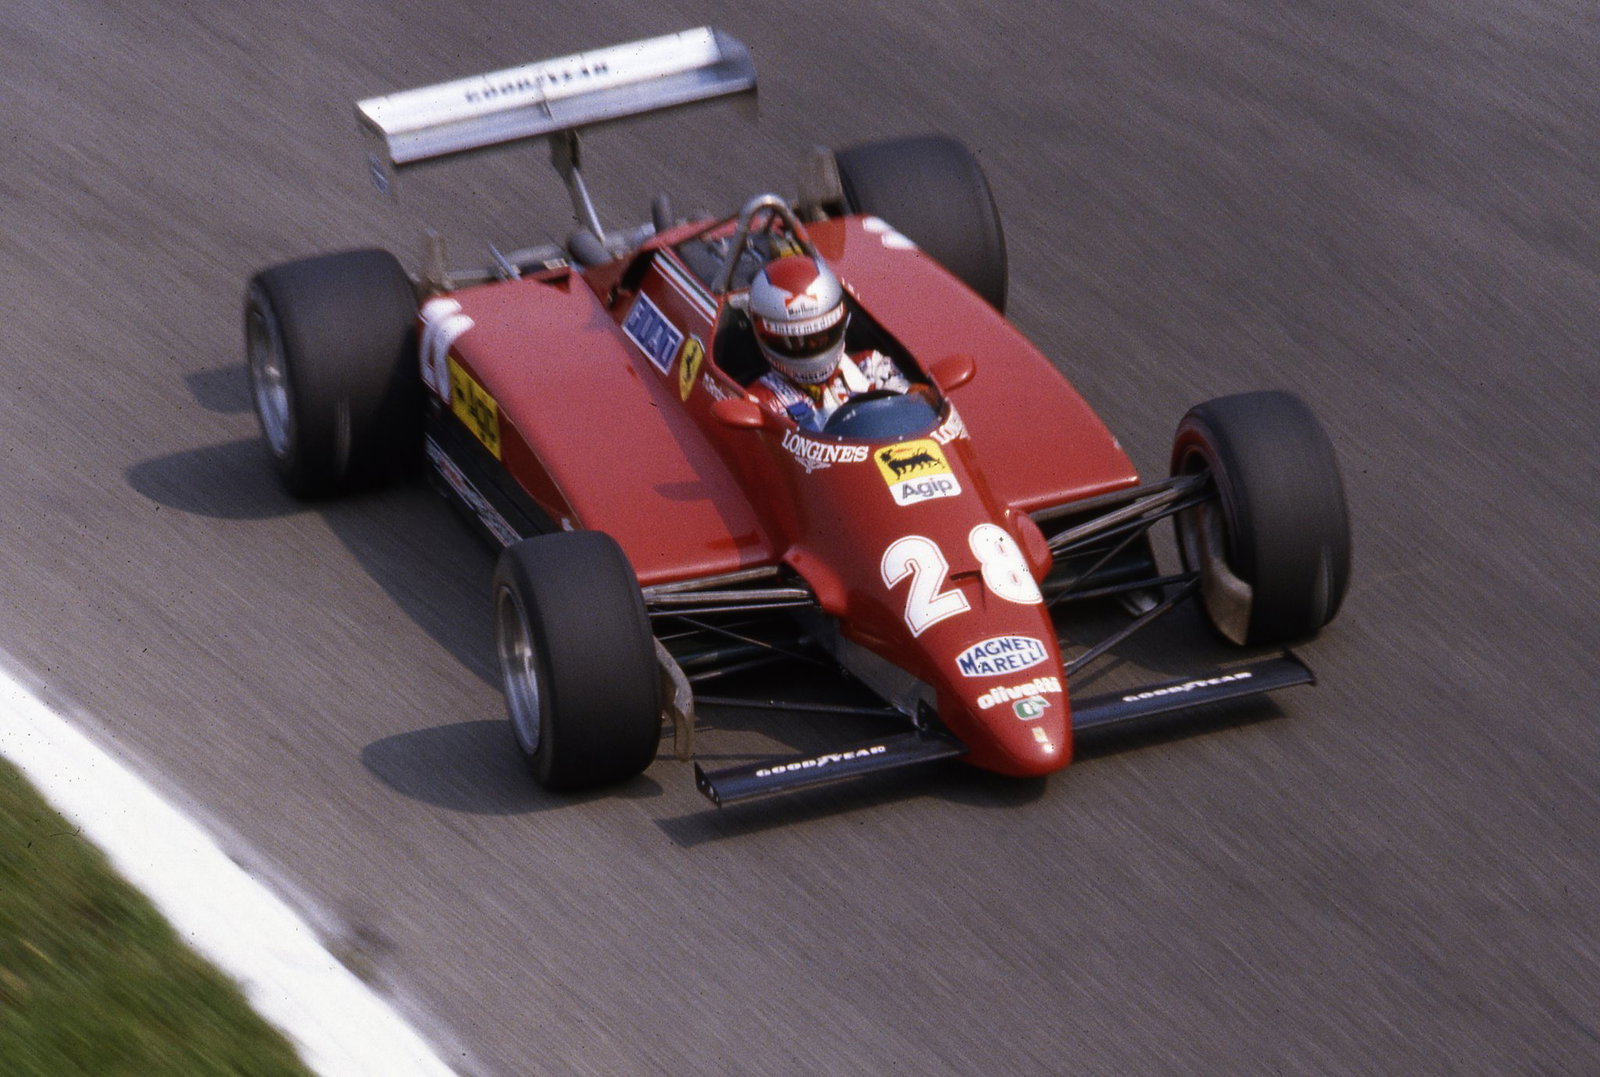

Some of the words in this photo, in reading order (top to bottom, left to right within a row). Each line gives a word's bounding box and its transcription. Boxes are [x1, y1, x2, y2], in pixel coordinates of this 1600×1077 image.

[627, 301, 677, 362] FIAT
[781, 428, 869, 462] LONGINES
[902, 478, 953, 499] Agip
[881, 523, 1043, 638] 28
[959, 647, 1045, 675] MARELLI
[977, 676, 1062, 710] olivetti
[1122, 672, 1252, 702] GOODYEAR
[756, 745, 886, 778] GOODYEAR
